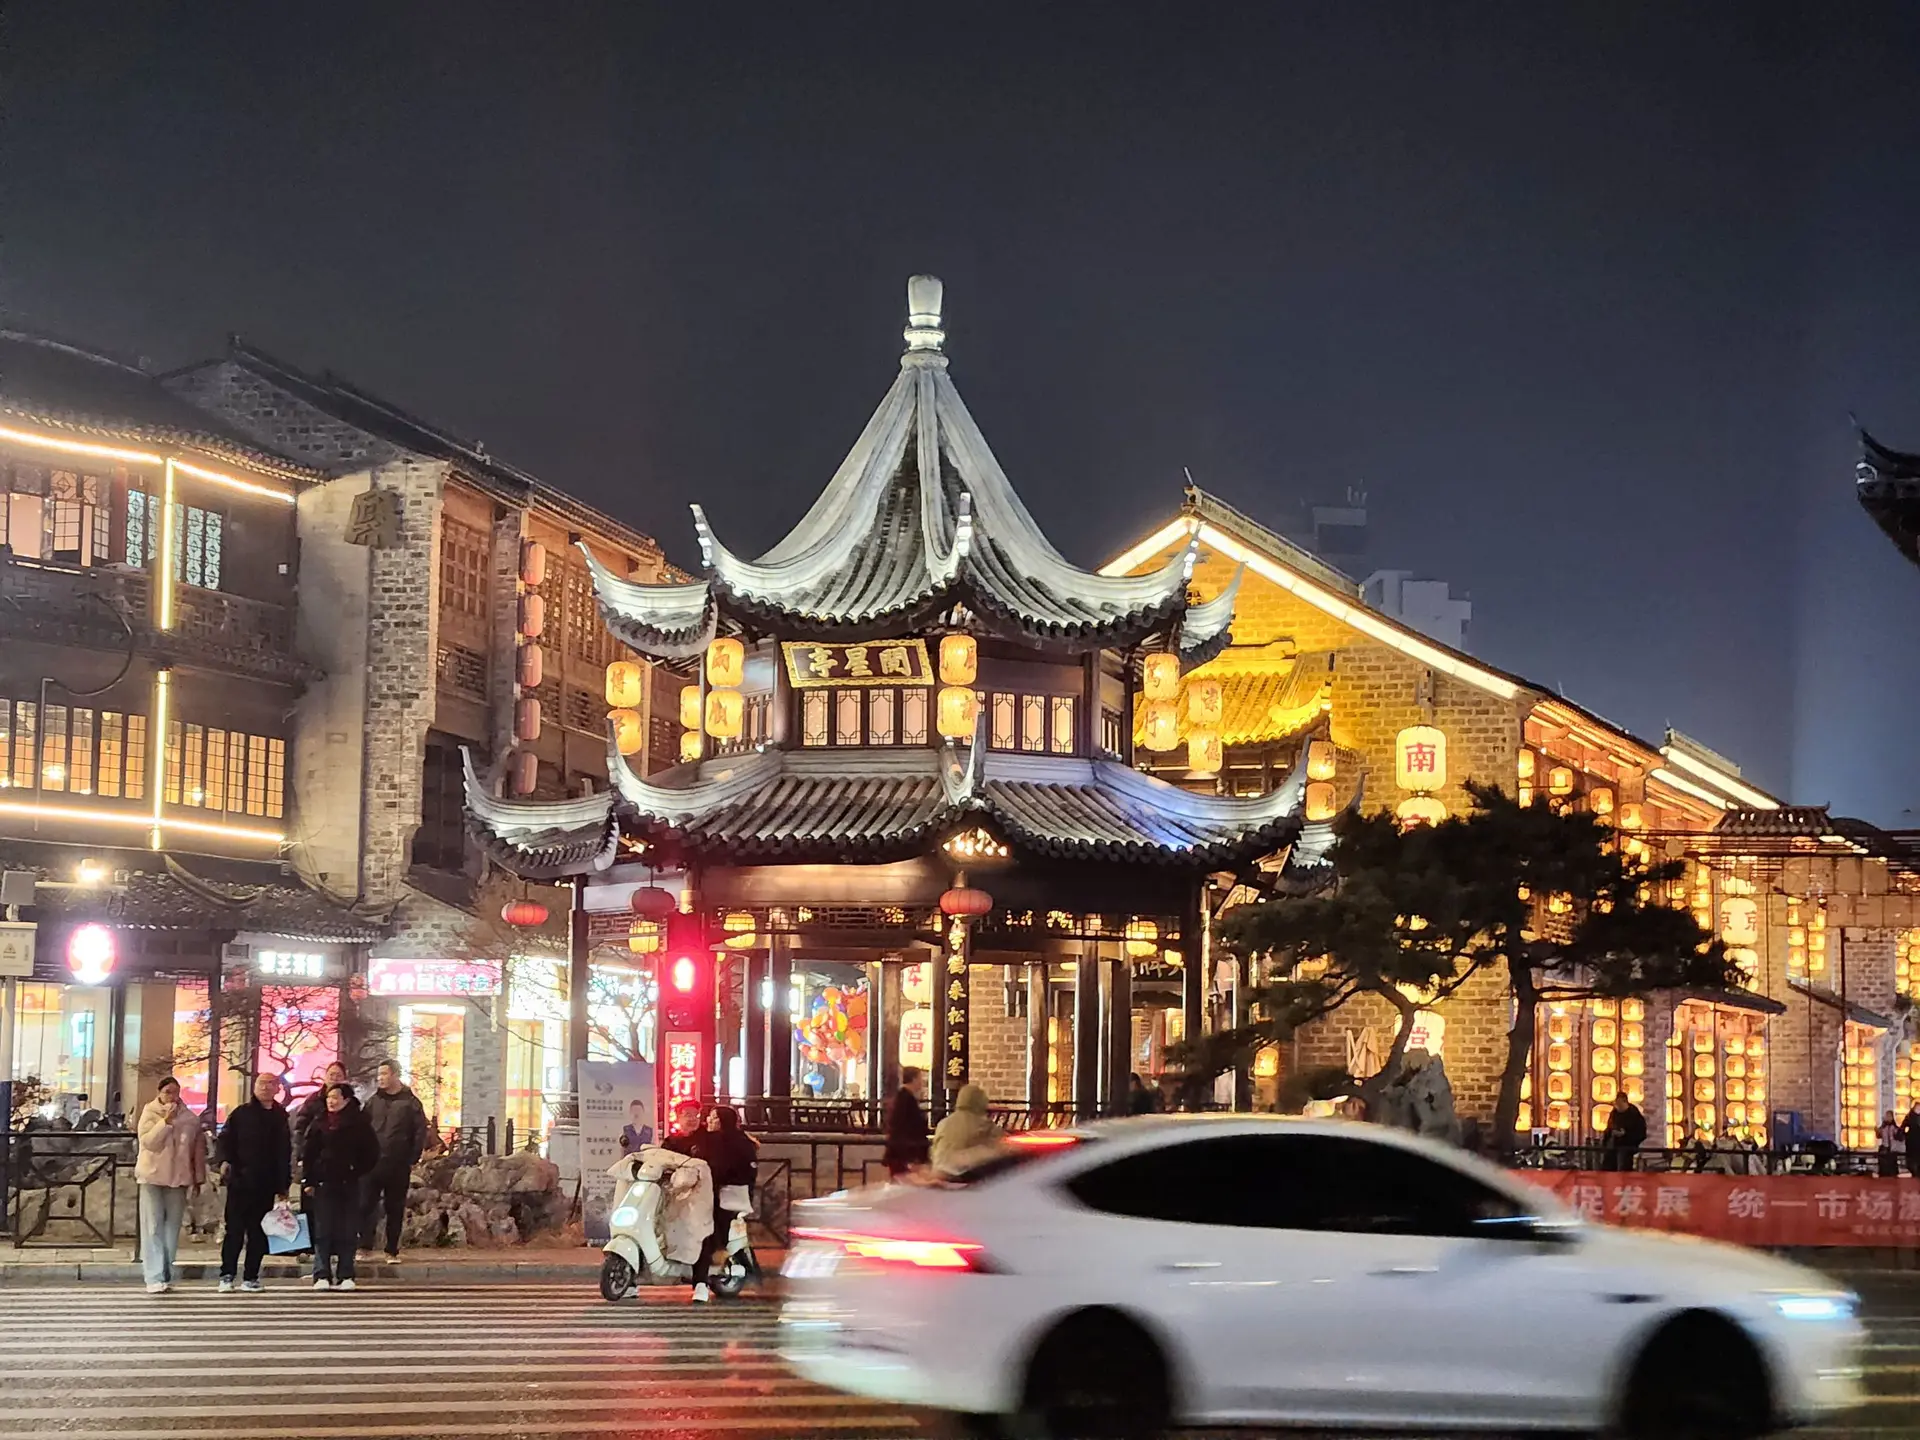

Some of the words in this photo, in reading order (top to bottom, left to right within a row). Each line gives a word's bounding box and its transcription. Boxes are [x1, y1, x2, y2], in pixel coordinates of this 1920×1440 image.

[1405, 743, 1436, 772] 南
[669, 1042, 696, 1133] 骑行
[1528, 1184, 1691, 1219] 促发展
